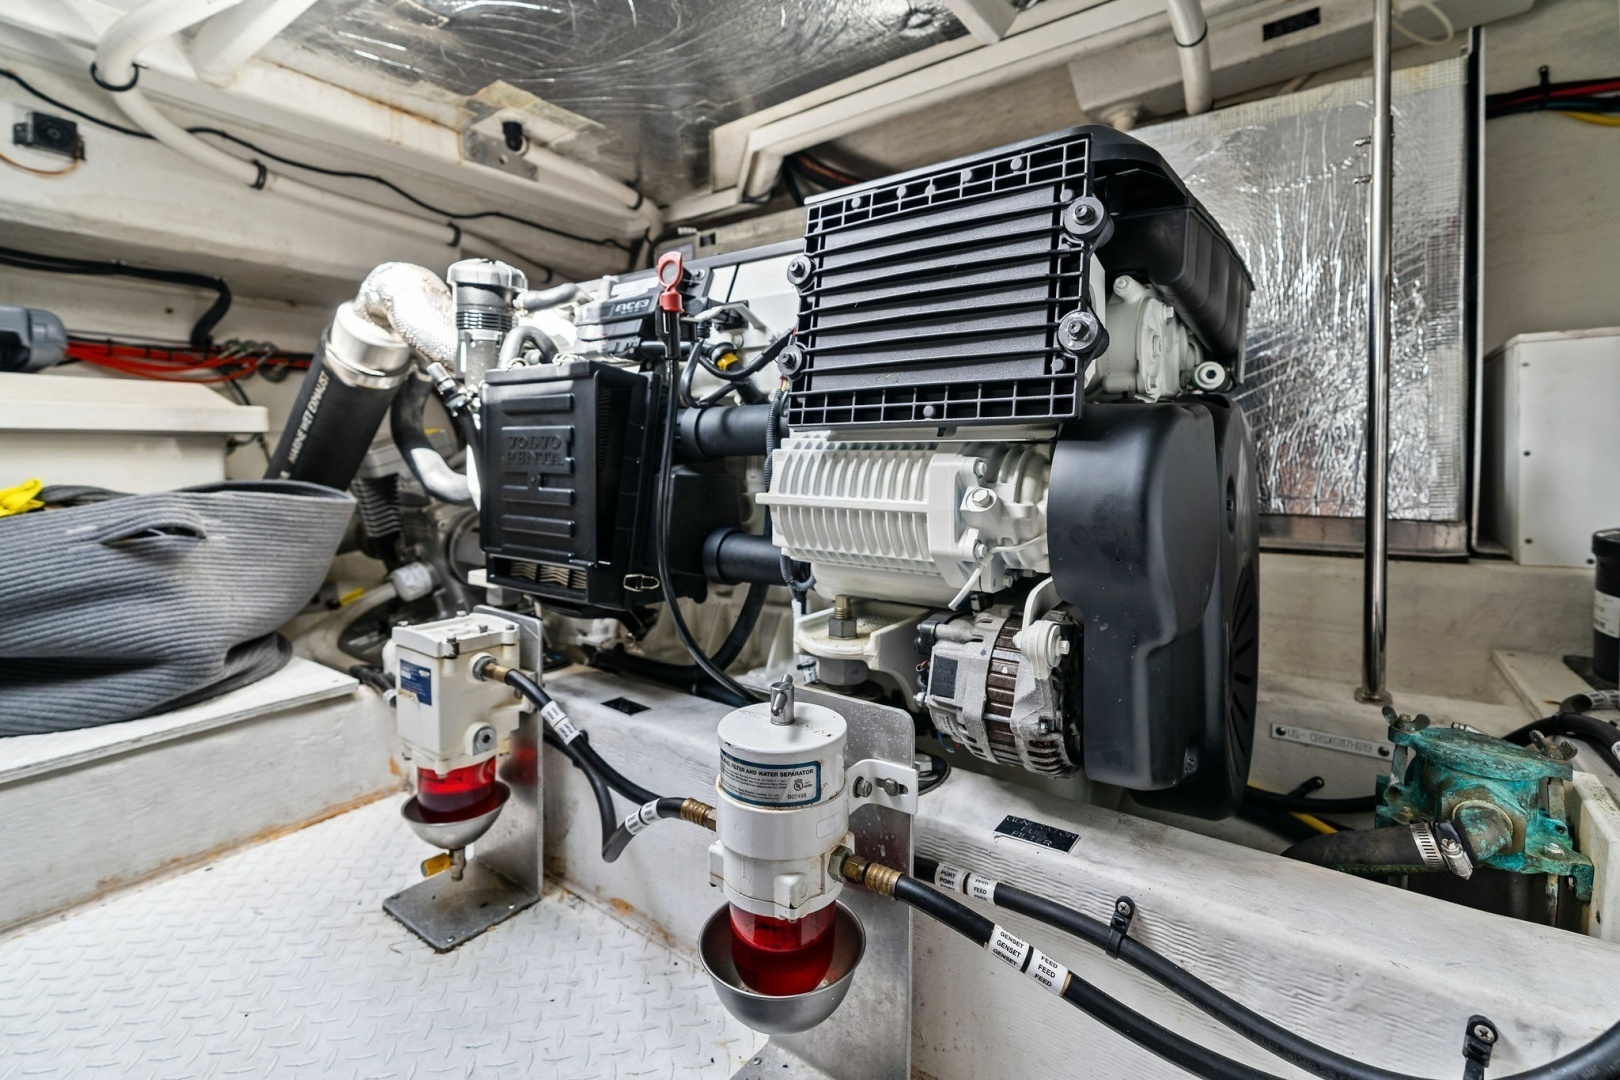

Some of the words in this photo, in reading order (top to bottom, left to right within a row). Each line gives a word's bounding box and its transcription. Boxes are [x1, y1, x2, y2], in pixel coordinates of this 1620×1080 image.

[300, 409, 314, 432] WET
[307, 370, 330, 414] EXHAUST
[504, 434, 562, 450] VOLVO
[504, 451, 565, 466] PENTA
[731, 763, 745, 774] FILTER
[780, 768, 814, 778] SEPARATOR
[1006, 816, 1077, 840] GENERATOR
[1021, 826, 1049, 839] FUEL
[1011, 830, 1053, 847] FILTER
[939, 876, 955, 887] PORT
[973, 886, 987, 895] FEED
[996, 939, 1022, 959] GENSET
[1037, 963, 1056, 979] FEED
[1000, 931, 1025, 949] GENSET
[1040, 955, 1058, 969] FEED
[992, 948, 1018, 966] GENSET
[1034, 973, 1052, 987] FEED
